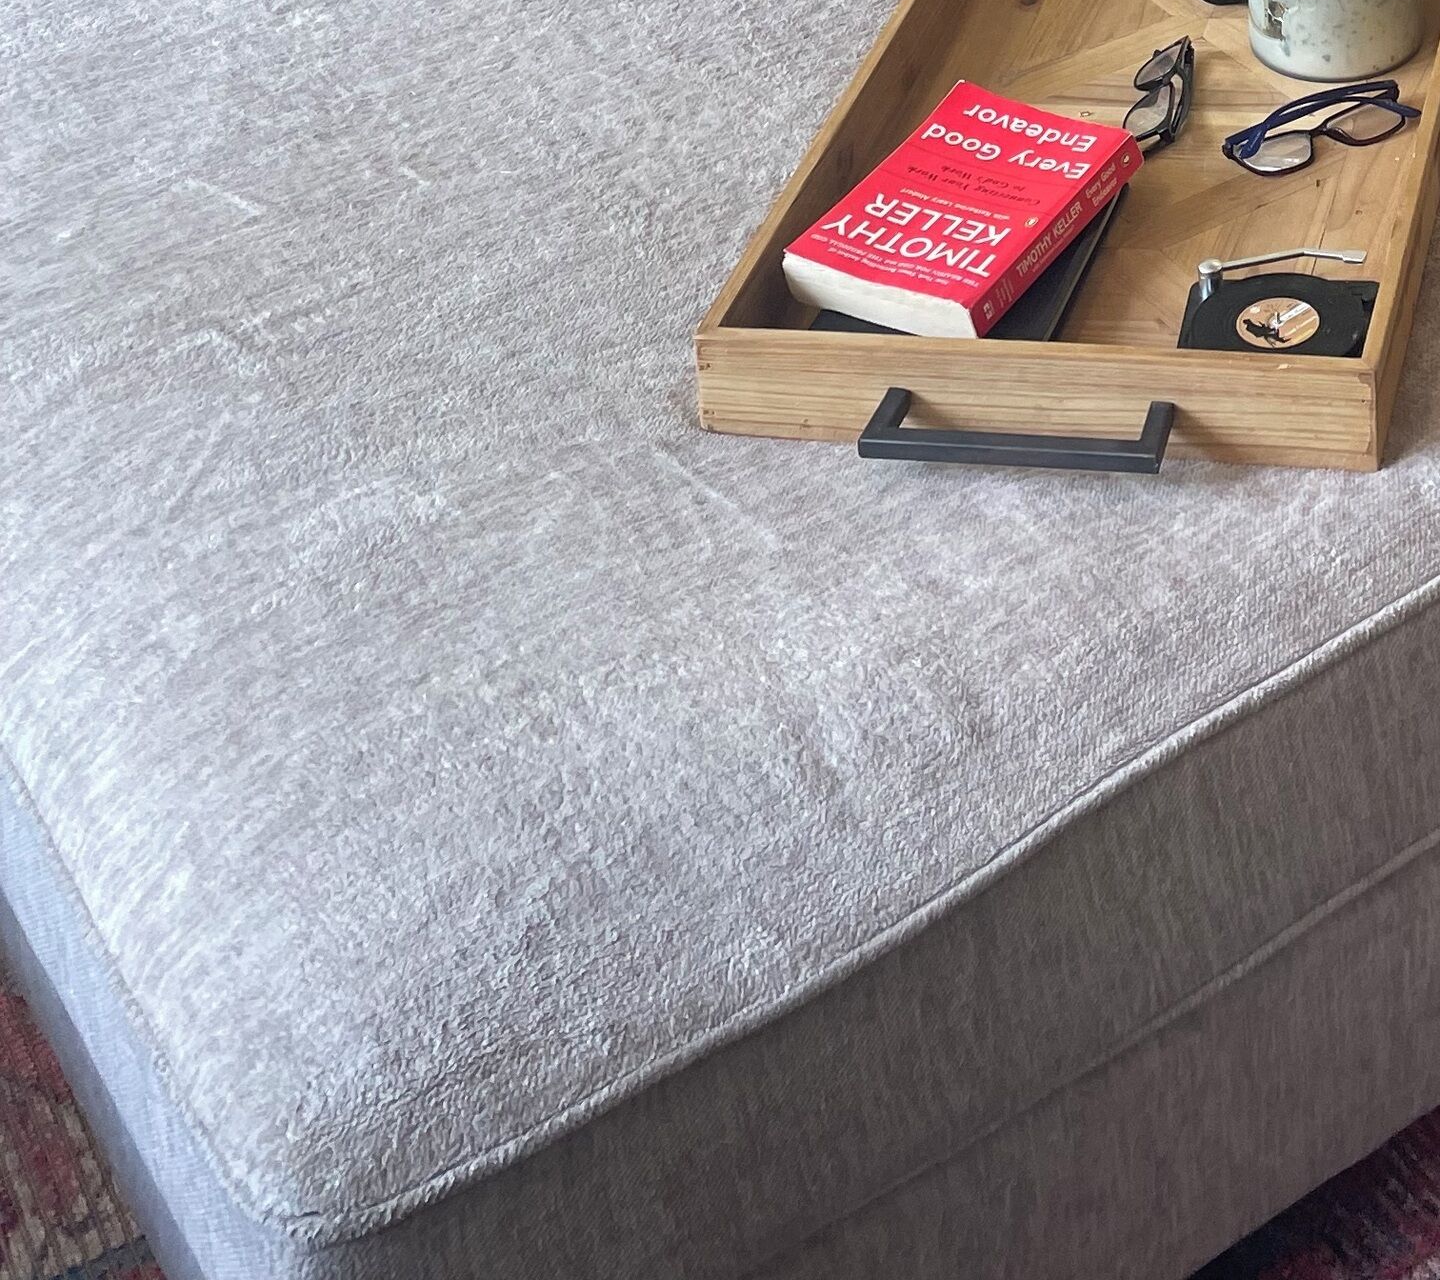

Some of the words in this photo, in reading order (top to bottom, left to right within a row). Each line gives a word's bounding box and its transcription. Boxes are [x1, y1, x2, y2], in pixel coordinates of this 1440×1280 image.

[920, 122, 1002, 161] Good
[962, 103, 1098, 152] Endeavor
[906, 166, 938, 182] Work
[940, 166, 971, 180] Work
[1008, 149, 1092, 180] Every
[1085, 180, 1101, 198] Every
[1100, 162, 1116, 181] Good
[940, 178, 969, 191] Your
[974, 185, 1040, 206] Connecting
[1091, 177, 1118, 206] Endeavor
[864, 192, 1012, 247] KELLER
[819, 213, 998, 278] TIMOTHY
[1017, 233, 1053, 277] TIMOTHY
[1052, 201, 1083, 237] KELLER
